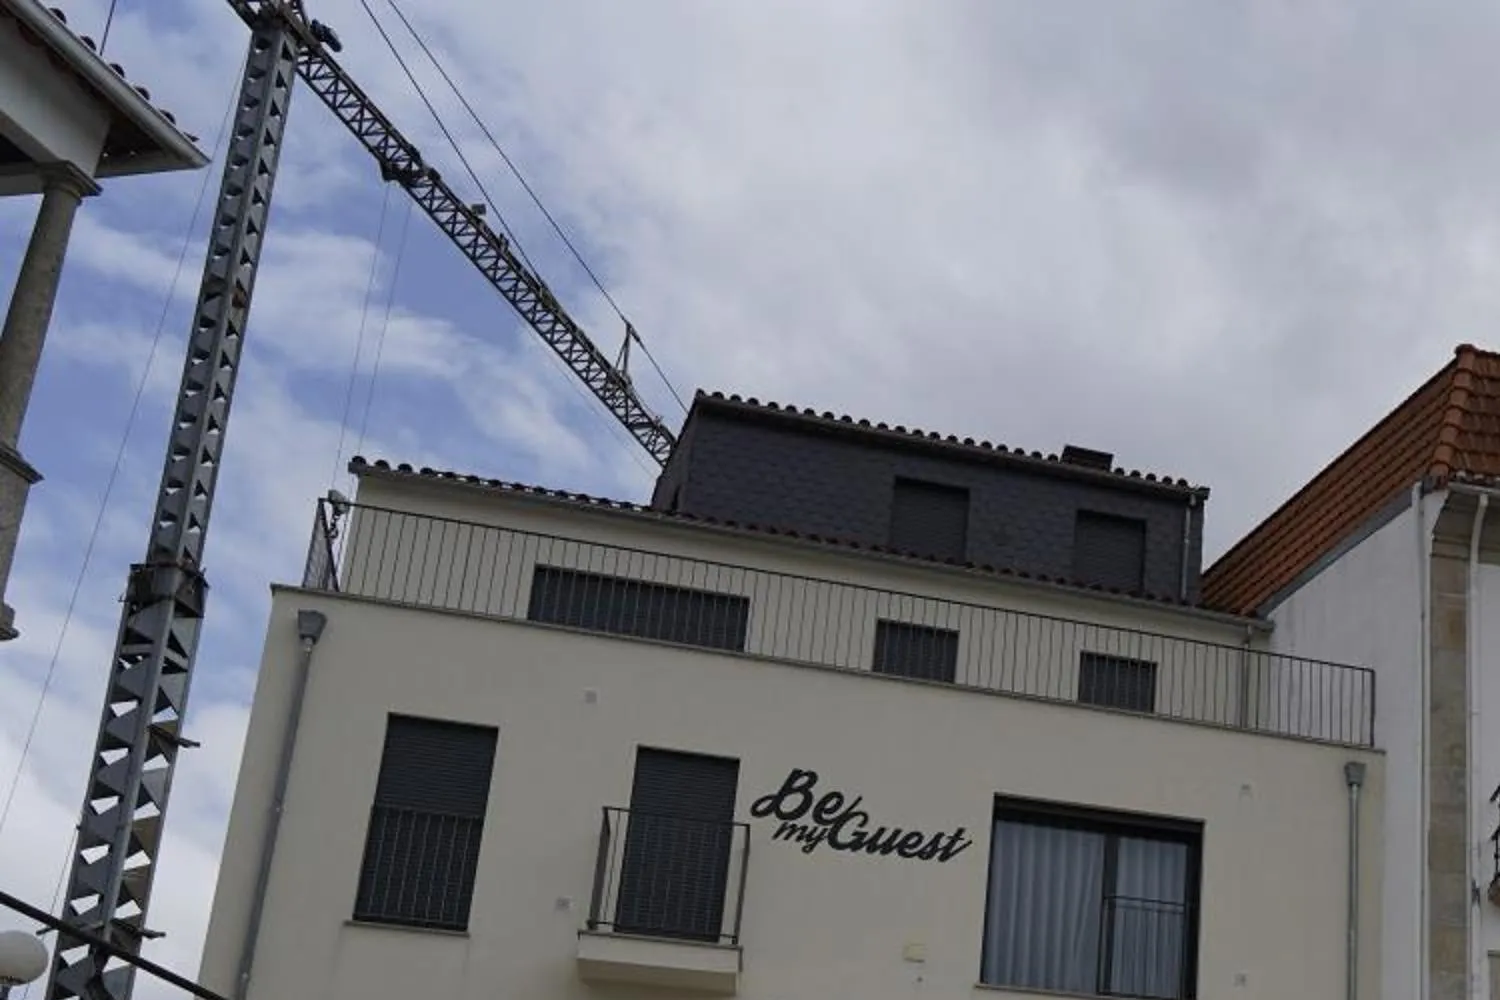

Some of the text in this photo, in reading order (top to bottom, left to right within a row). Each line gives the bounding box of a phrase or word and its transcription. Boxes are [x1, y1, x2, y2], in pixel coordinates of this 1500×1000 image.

[750, 768, 862, 825] Be
[772, 811, 973, 863] my Guest
